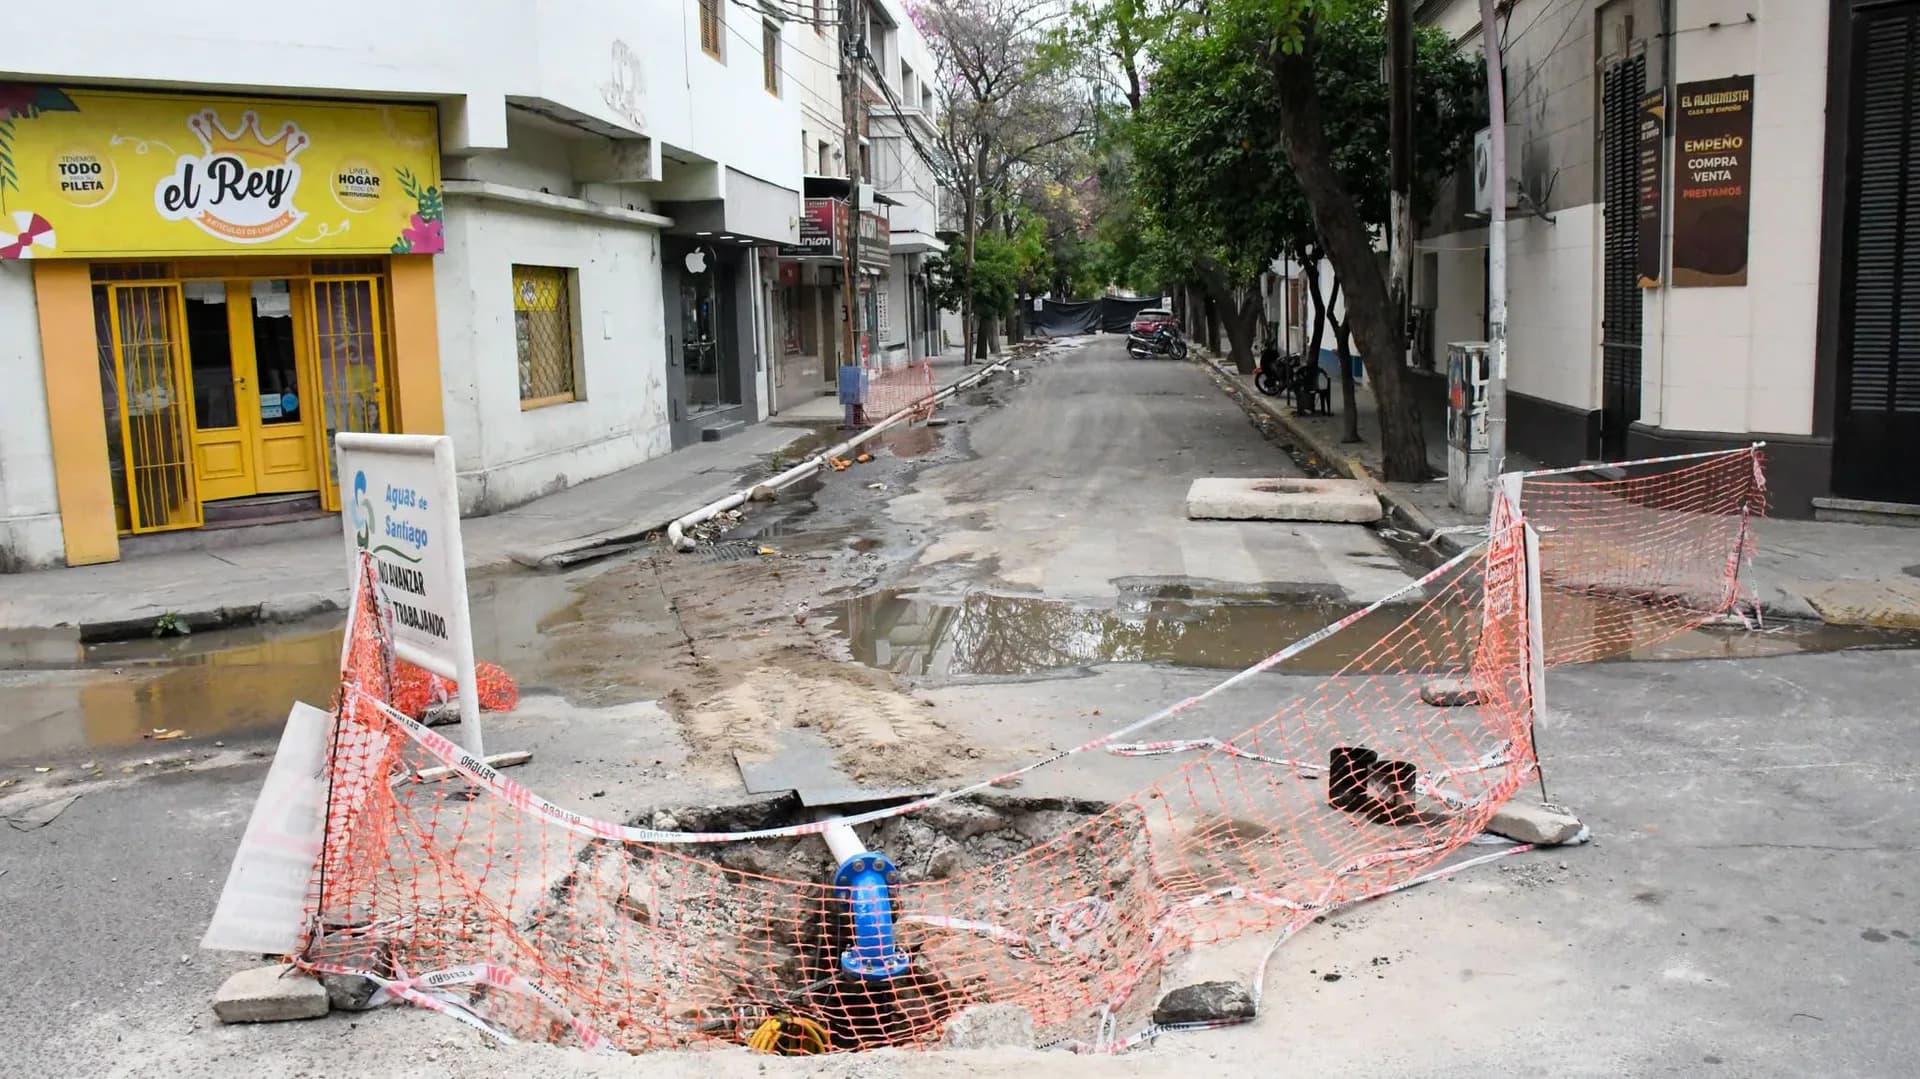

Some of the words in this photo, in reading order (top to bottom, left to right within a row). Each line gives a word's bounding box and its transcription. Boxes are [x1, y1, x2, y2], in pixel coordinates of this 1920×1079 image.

[1681, 96, 1693, 108] EL
[1694, 89, 1750, 106] ALQUIMISTA
[1684, 133, 1744, 152] EMPEÑO
[58, 162, 102, 175] TODO
[1687, 156, 1738, 169] COMPRA
[338, 173, 380, 186] HOGAR
[1693, 170, 1732, 182] VENTA
[60, 180, 105, 192] PILETA
[163, 163, 201, 212] el
[207, 157, 293, 209] Rey
[1683, 185, 1742, 198] PRESTAMOS
[385, 483, 416, 511] Aguas
[418, 496, 428, 510] de
[385, 514, 428, 550] Santiago
[378, 559, 389, 585] NO
[389, 562, 426, 597] AVANZAR
